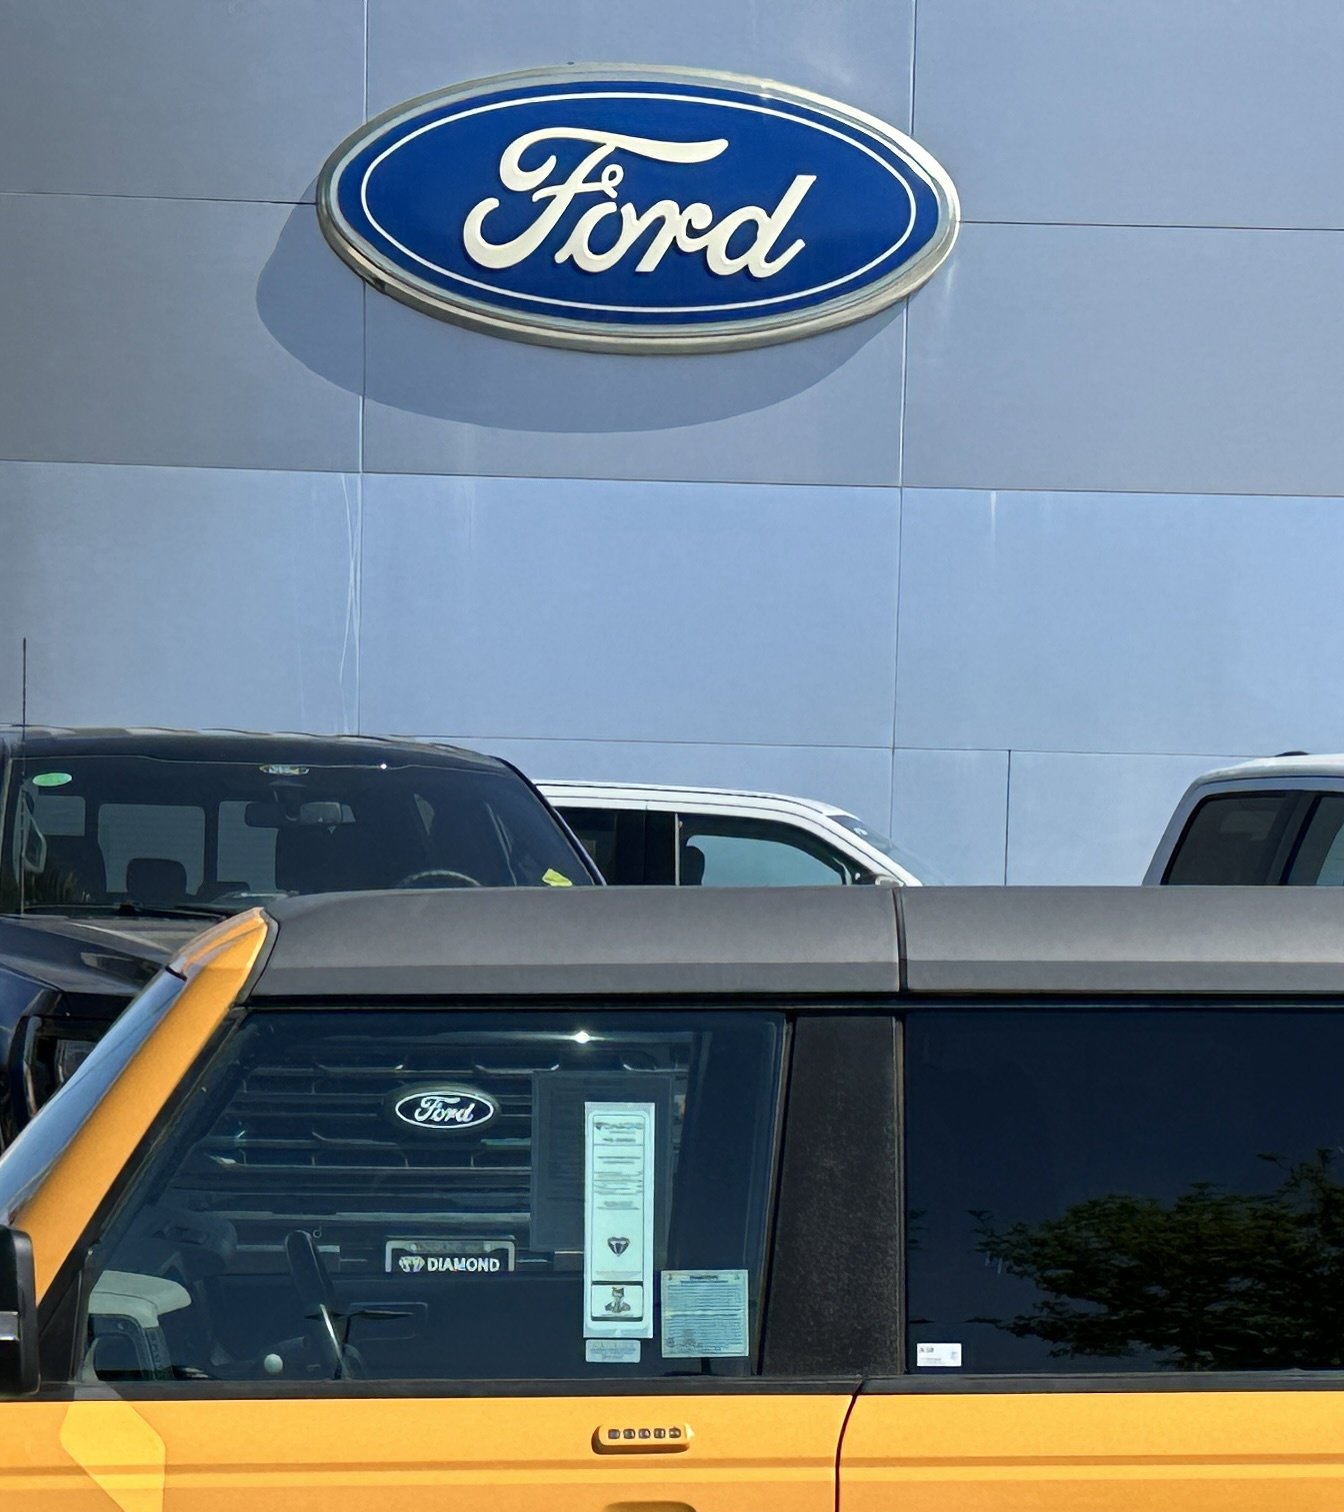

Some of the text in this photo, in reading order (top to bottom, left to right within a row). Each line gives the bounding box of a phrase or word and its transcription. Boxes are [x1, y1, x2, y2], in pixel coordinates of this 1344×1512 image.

[462, 127, 817, 279] Ford
[414, 1095, 476, 1122] Ford
[427, 1257, 500, 1272] DIAMOND
